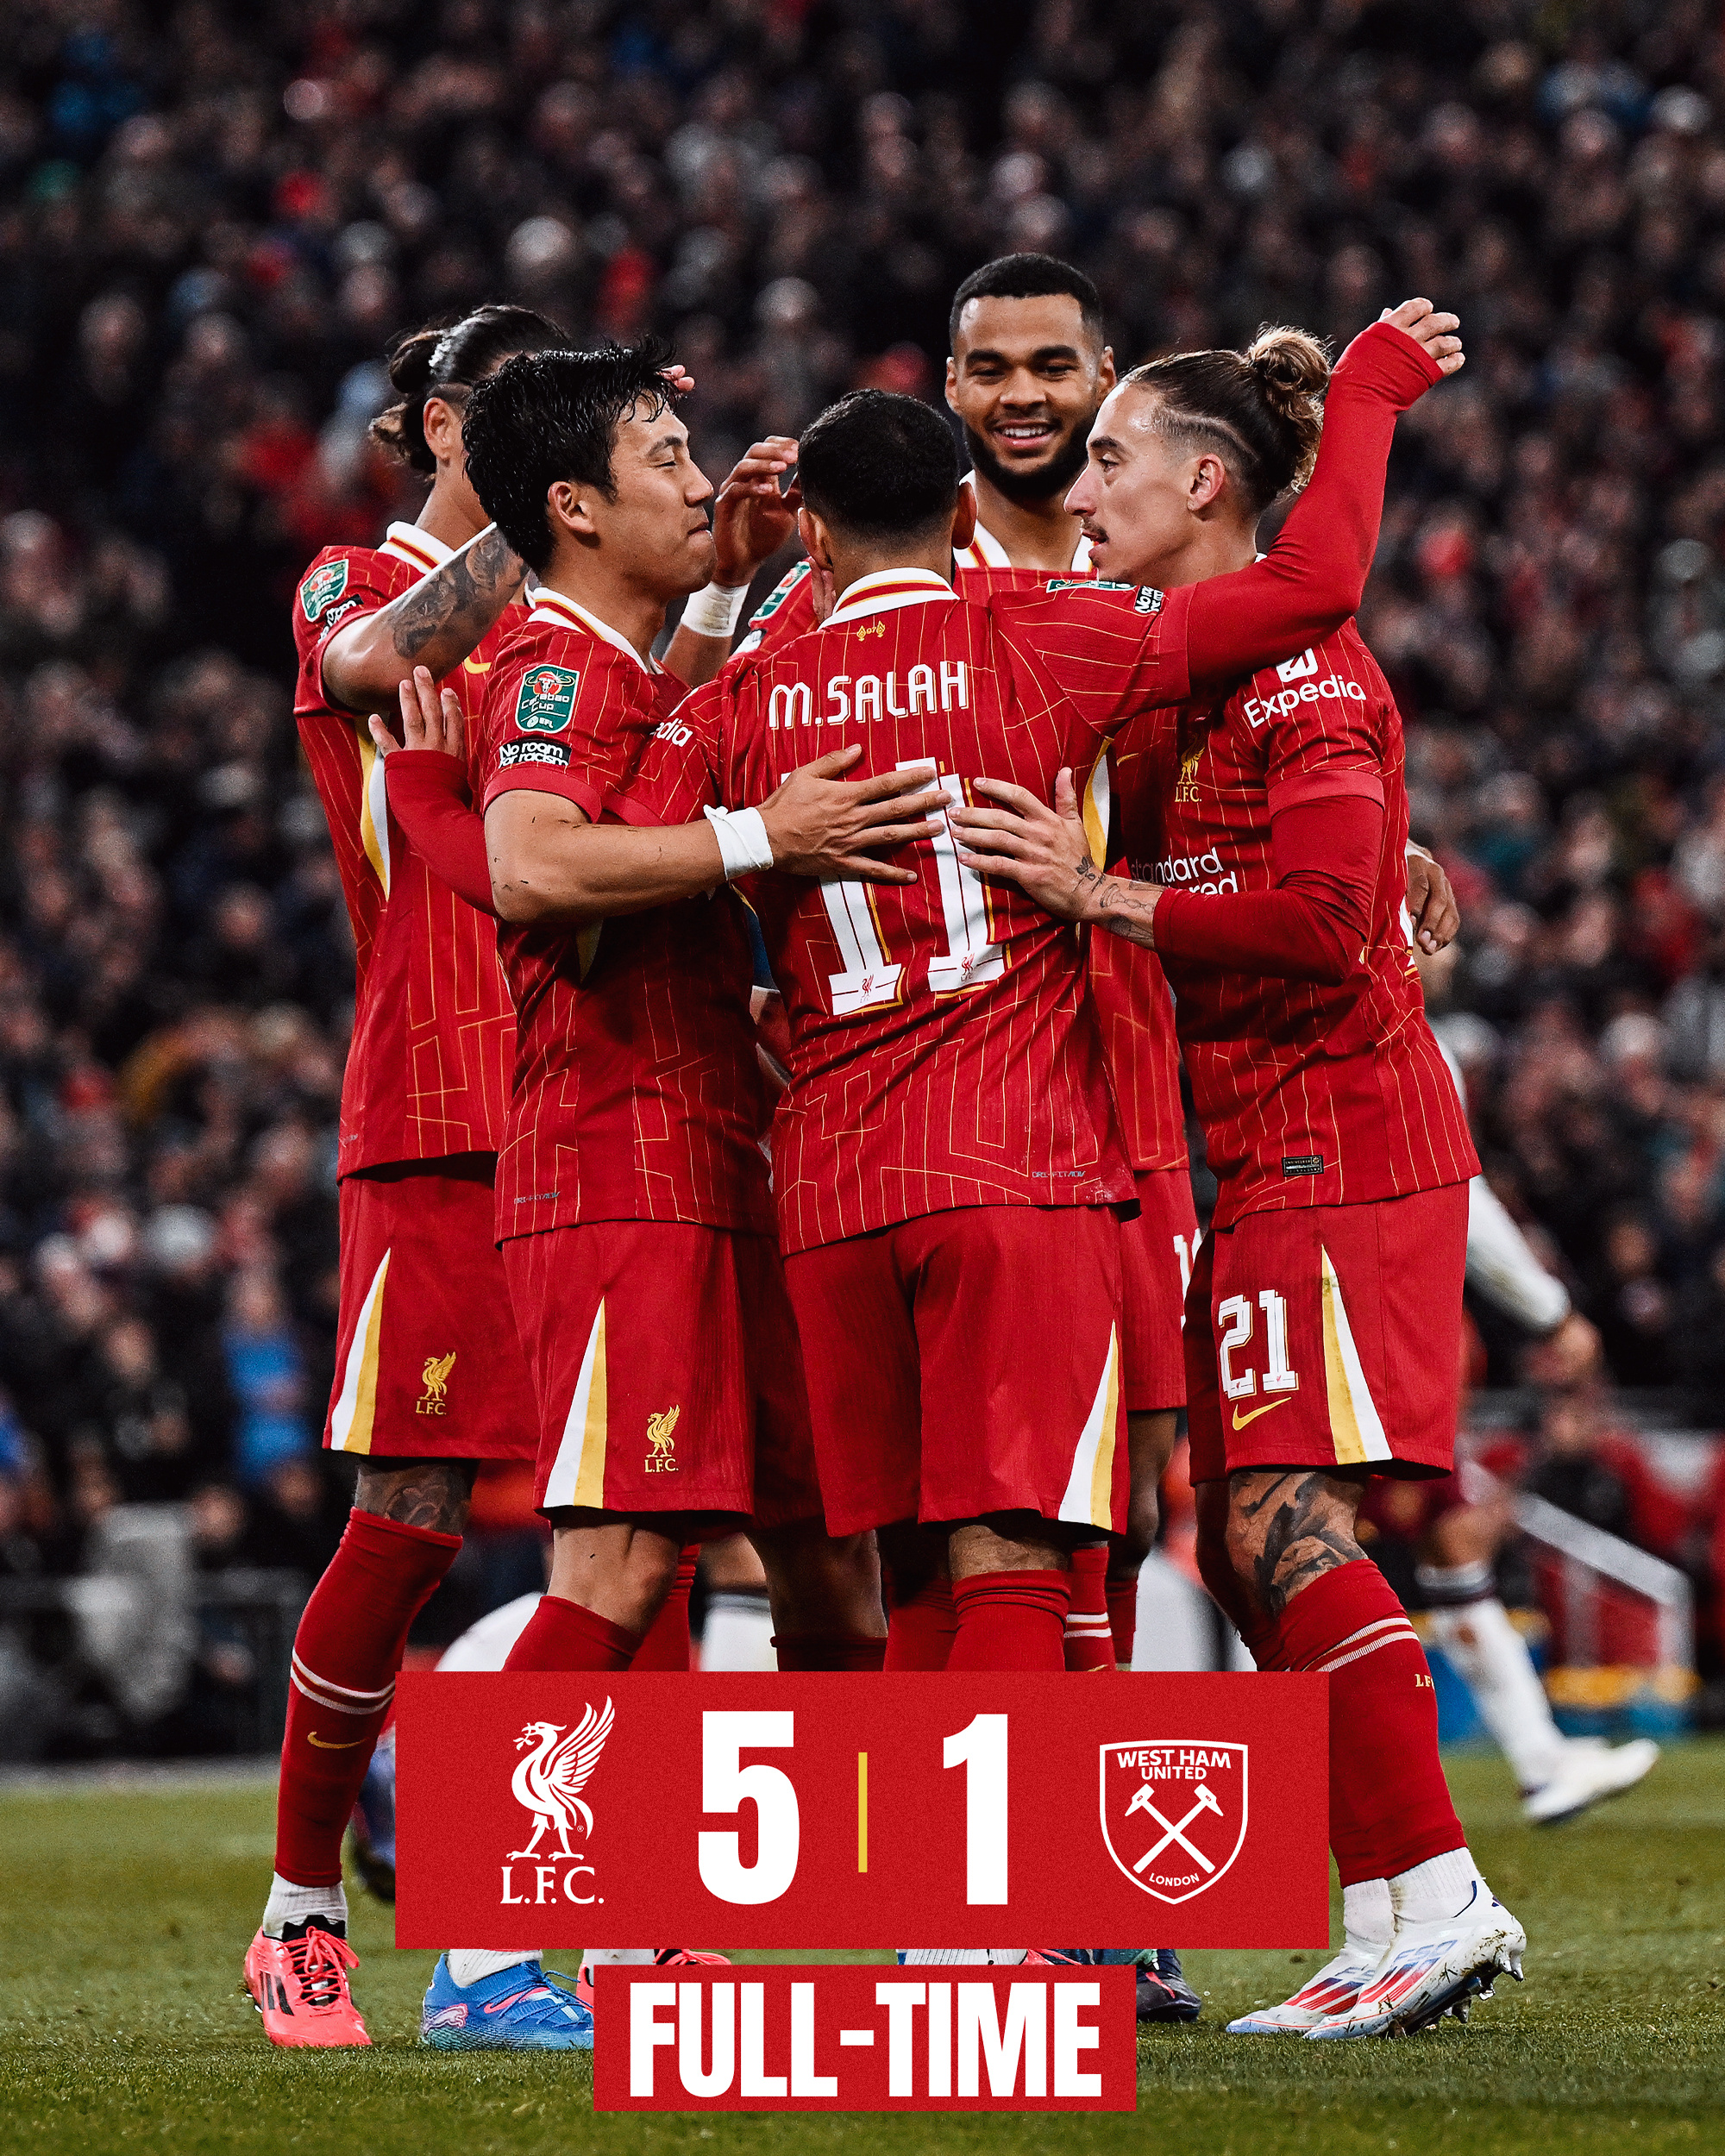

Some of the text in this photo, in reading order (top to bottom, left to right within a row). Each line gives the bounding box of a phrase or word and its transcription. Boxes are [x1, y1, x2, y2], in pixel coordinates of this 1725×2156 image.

[521, 693, 570, 710] Carabao
[768, 661, 969, 730] M.SALAH
[1243, 674, 1367, 729] Expedia
[530, 701, 555, 712] Cup
[538, 717, 554, 729] EFL
[499, 742, 564, 759] No room
[518, 752, 569, 767] racism
[1174, 786, 1202, 803] L.F.C.
[1218, 1289, 1300, 1402] 21
[644, 1458, 680, 1473] L.F.C.
